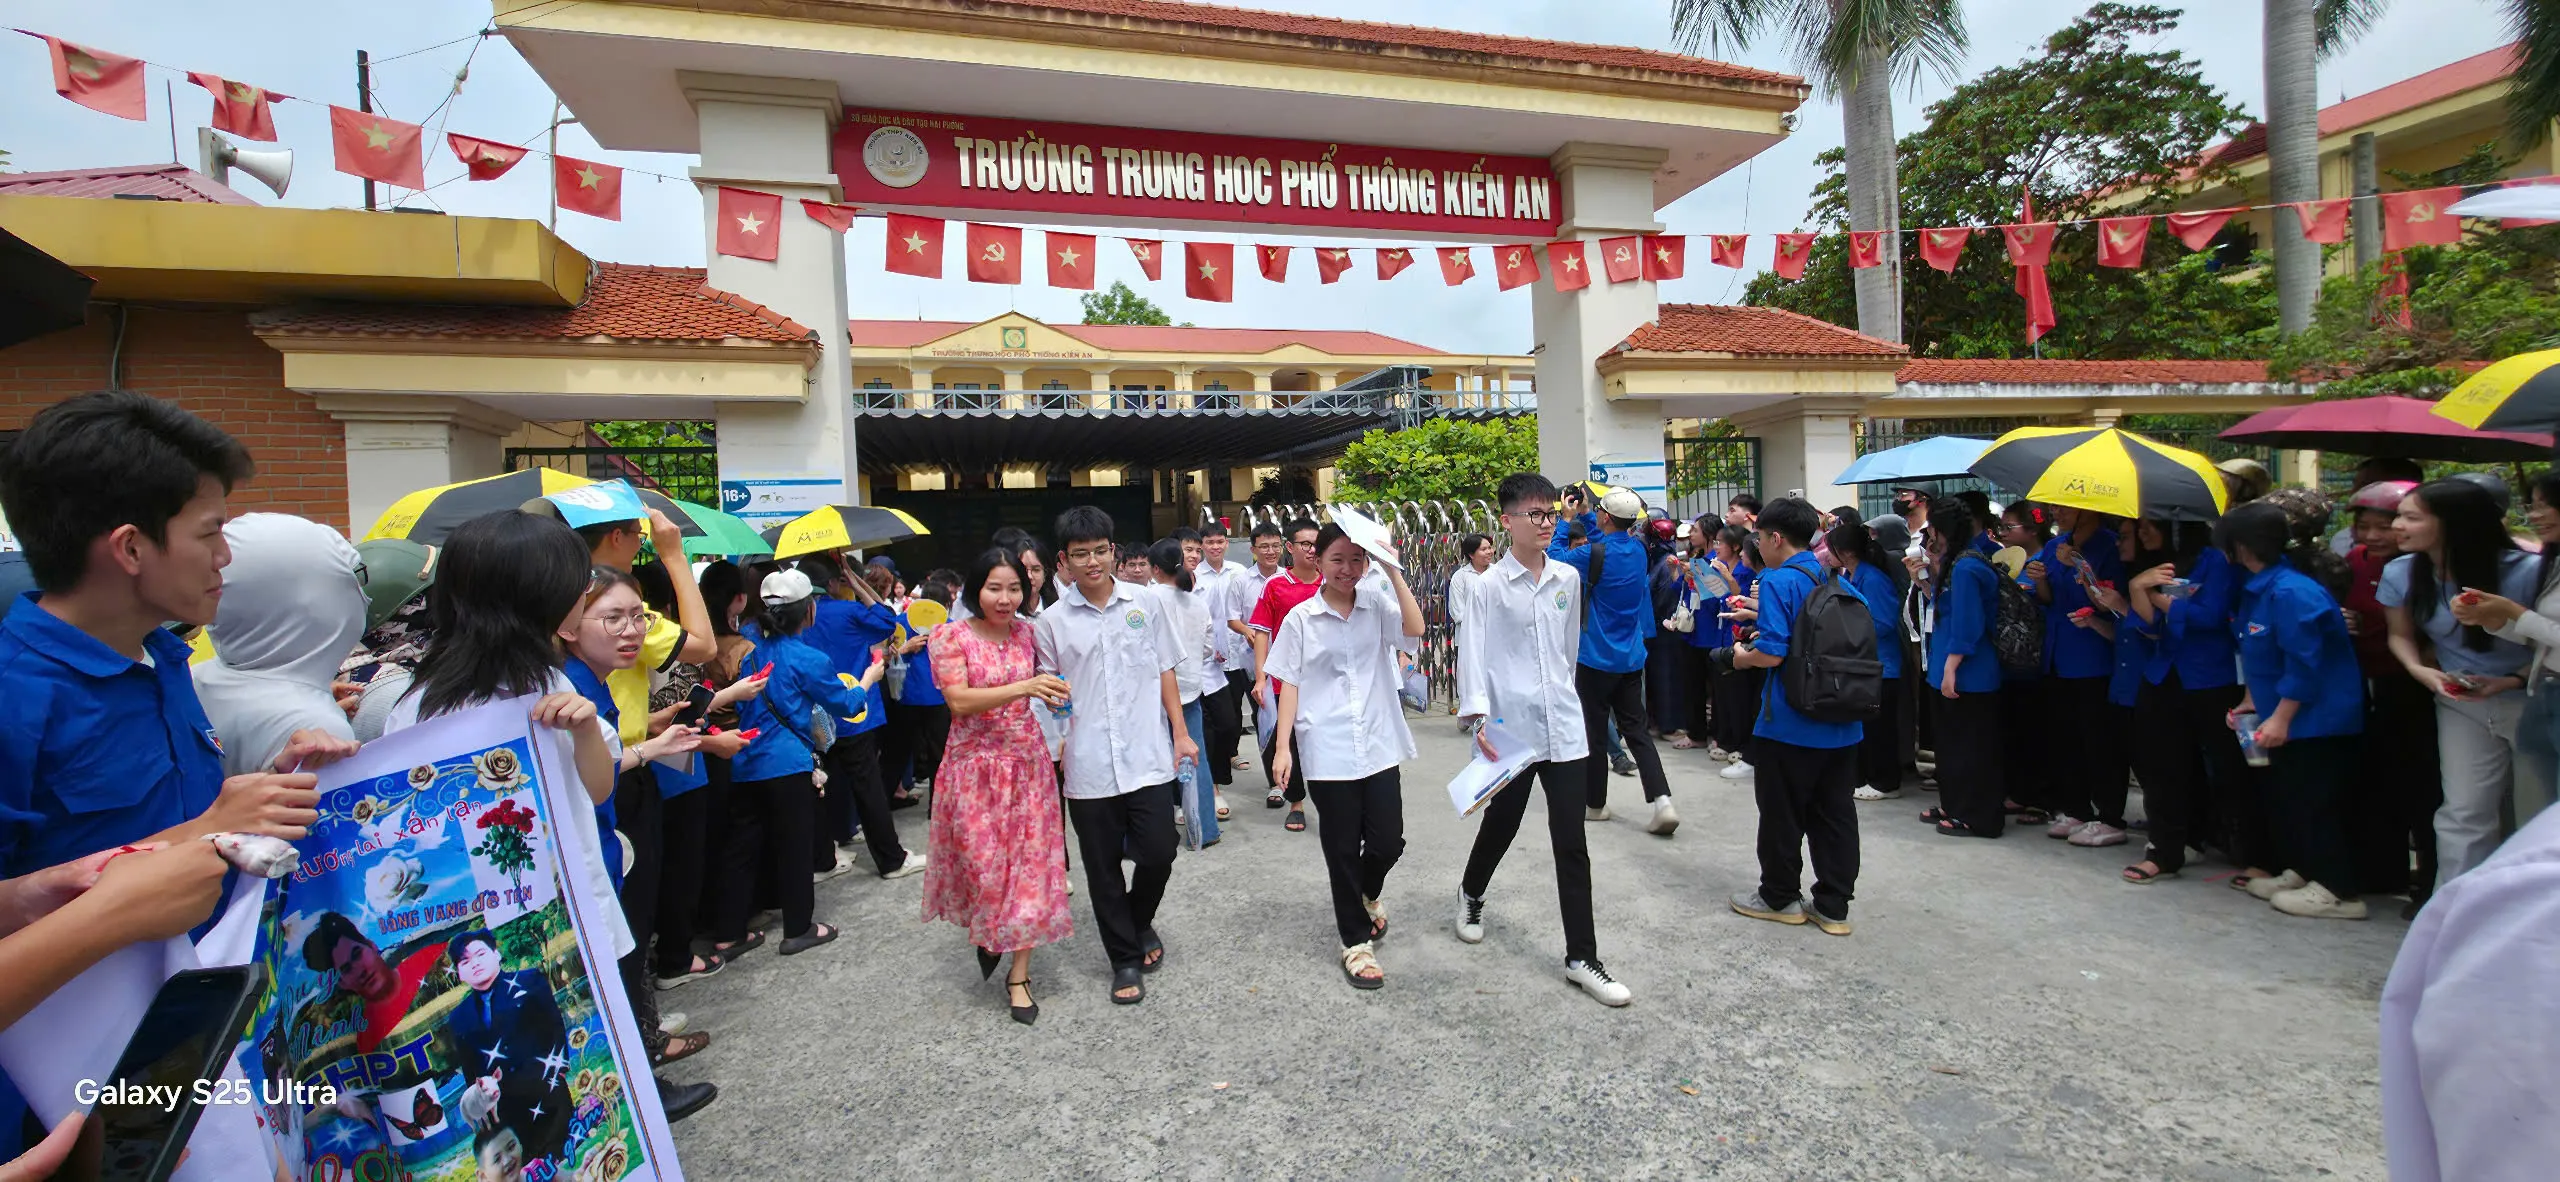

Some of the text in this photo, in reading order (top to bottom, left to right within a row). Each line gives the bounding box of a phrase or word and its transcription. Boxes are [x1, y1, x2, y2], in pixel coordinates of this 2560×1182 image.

[954, 130, 1094, 194] TRƯỜNG
[1101, 146, 1205, 201] TRUNG
[1280, 143, 1338, 209] PHỔ
[1345, 156, 1436, 214] THÔNG
[1443, 158, 1506, 218] KIẾN
[1513, 175, 1551, 220] AN
[1590, 470, 1606, 481] 16+
[723, 489, 748, 502] 16+
[356, 831, 383, 856] lai
[394, 801, 439, 841] xán
[445, 799, 483, 822] lạn
